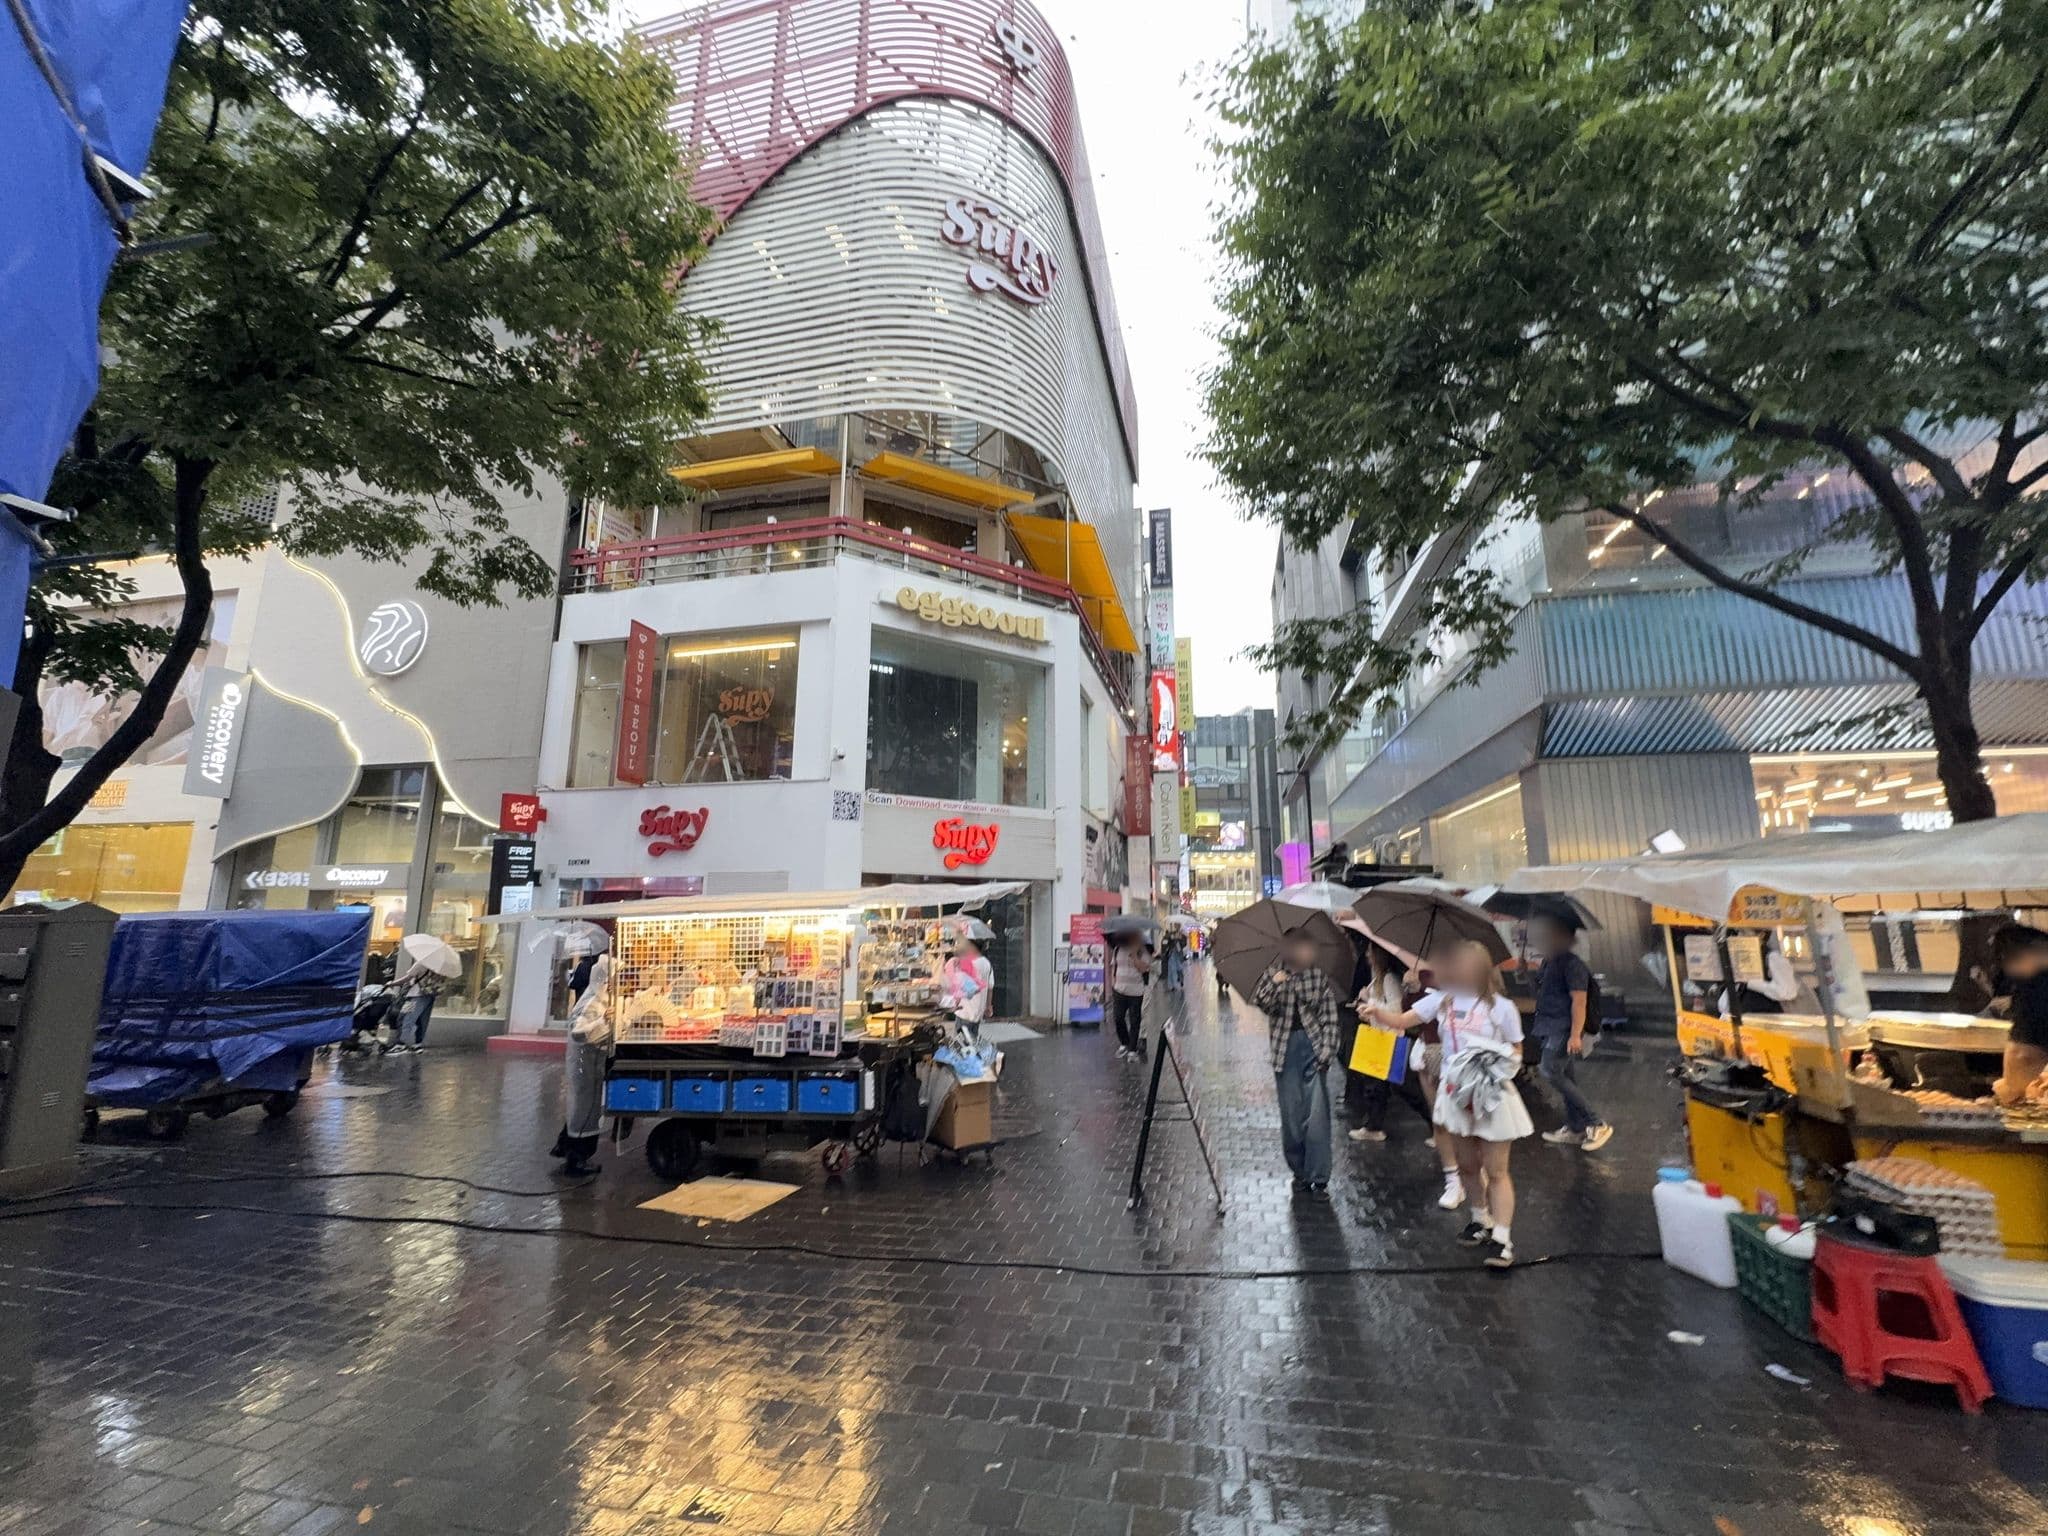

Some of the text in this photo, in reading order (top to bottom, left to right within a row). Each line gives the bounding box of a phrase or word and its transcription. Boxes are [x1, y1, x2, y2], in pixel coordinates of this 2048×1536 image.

[941, 198, 1058, 306] Supy
[1155, 521, 1166, 576] MASSAGE
[896, 586, 1045, 642] eggseoul
[202, 683, 242, 784] Discovery
[628, 649, 645, 770] SUPY SEOUL
[718, 685, 776, 728] Supy
[200, 706, 219, 769] EXPEDITION
[510, 802, 535, 820] Supy
[868, 793, 893, 805] Scan
[895, 796, 941, 809] Download
[508, 846, 533, 856] FRIP
[639, 805, 709, 857] Supy
[933, 816, 999, 870] Supy
[326, 867, 389, 884] Discovery
